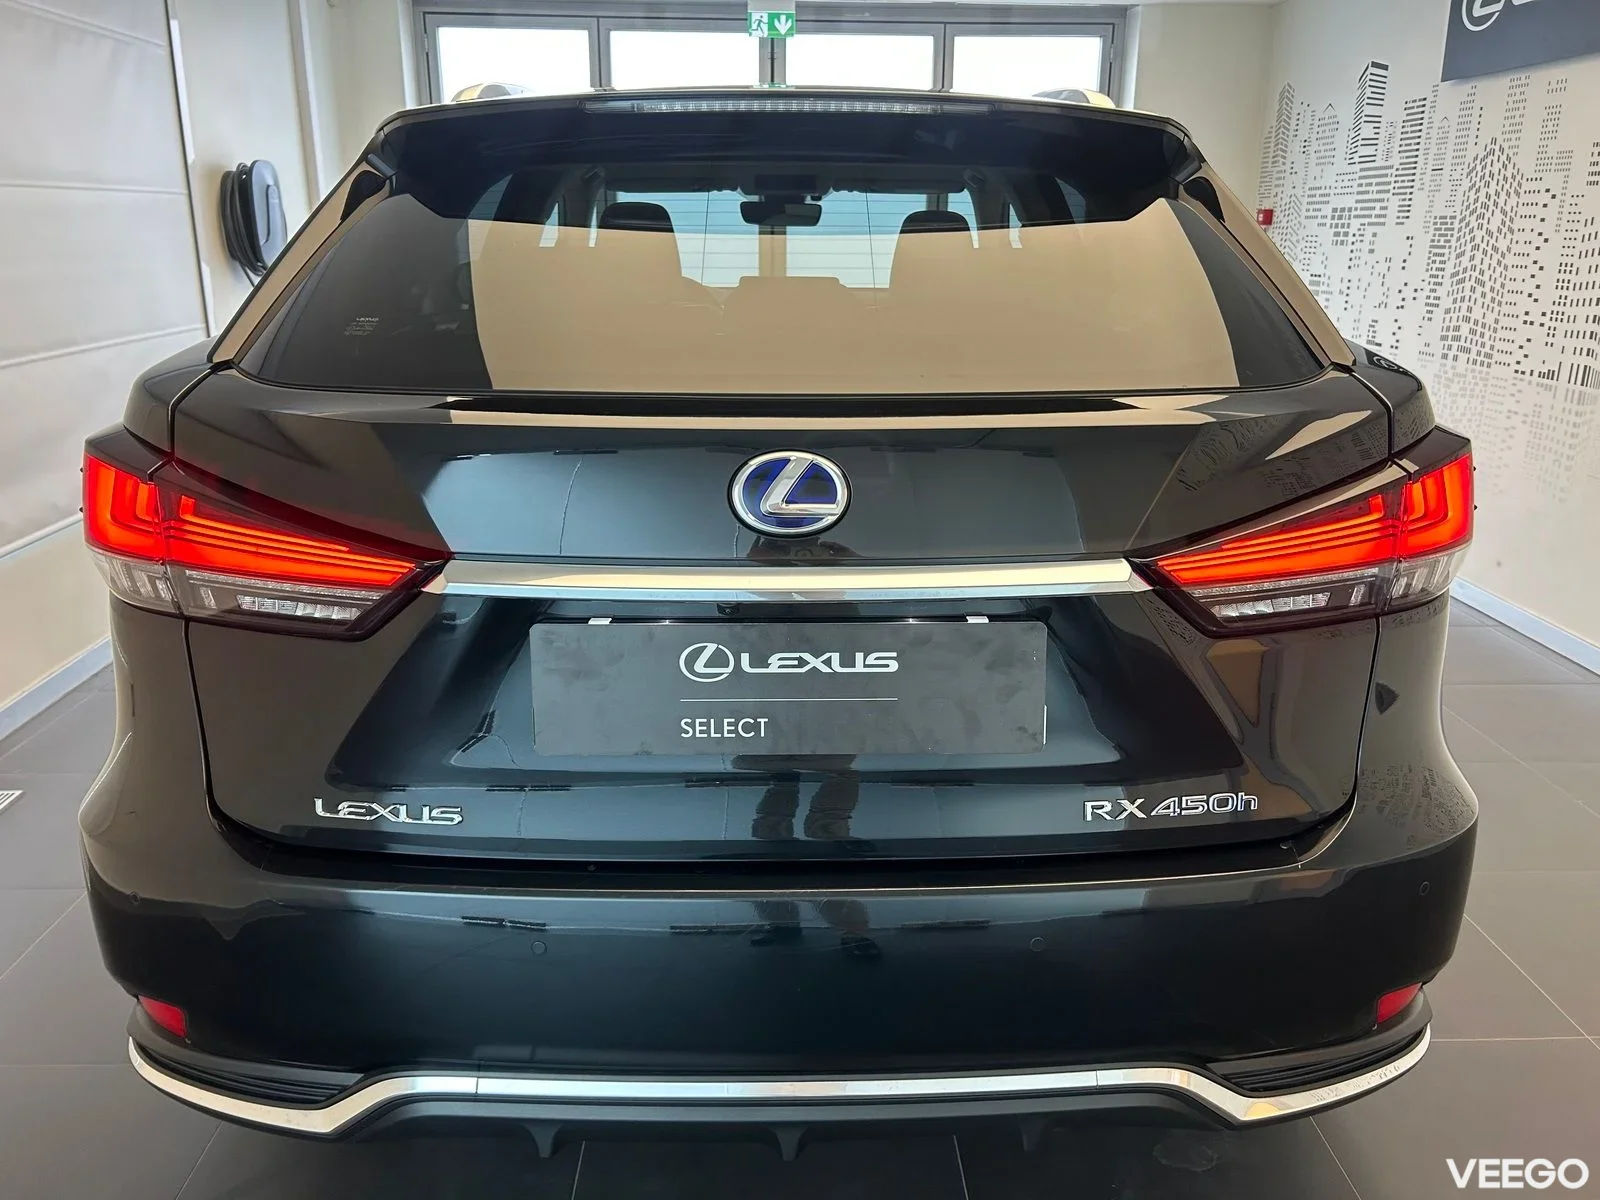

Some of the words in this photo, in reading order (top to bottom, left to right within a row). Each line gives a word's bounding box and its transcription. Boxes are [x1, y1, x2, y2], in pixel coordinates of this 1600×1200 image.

[740, 651, 899, 673] LEXUS
[680, 718, 769, 738] SELECT
[314, 797, 463, 826] LEXUS
[1084, 798, 1148, 822] RX
[1150, 791, 1259, 817] 450h
